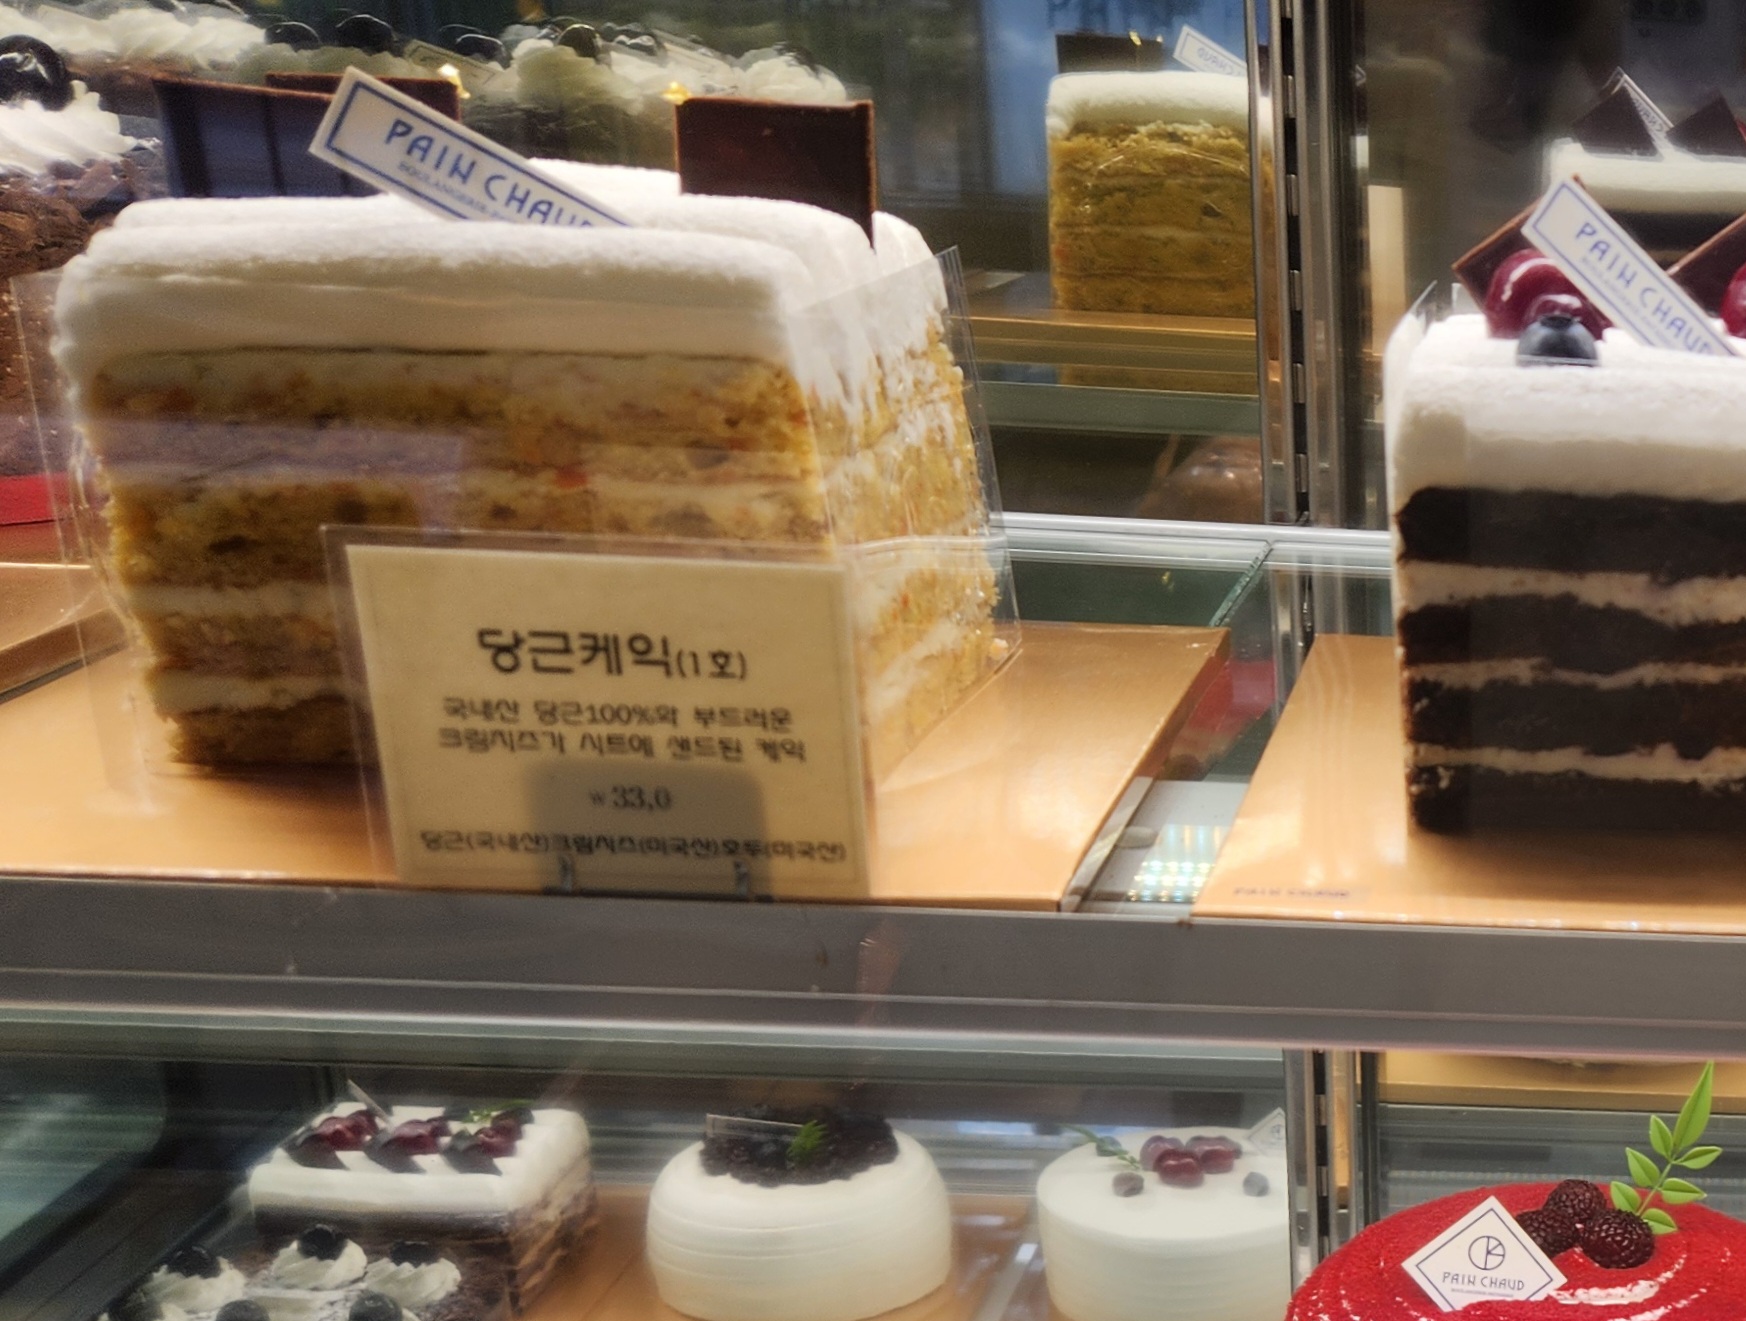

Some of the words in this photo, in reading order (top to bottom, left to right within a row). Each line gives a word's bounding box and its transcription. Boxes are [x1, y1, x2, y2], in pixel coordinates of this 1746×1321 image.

[385, 118, 477, 184] PAIN
[1575, 221, 1638, 289] PAIN
[477, 627, 747, 681] 당근케익(1호)
[443, 697, 520, 725] 국내산
[693, 706, 793, 734] 부드러운
[438, 726, 566, 754] 크림치즈가
[579, 731, 655, 758] 시트에
[667, 735, 743, 763] 샌드된
[1442, 1271, 1477, 1286] PAIN
[1480, 1275, 1525, 1291] CHAUD
